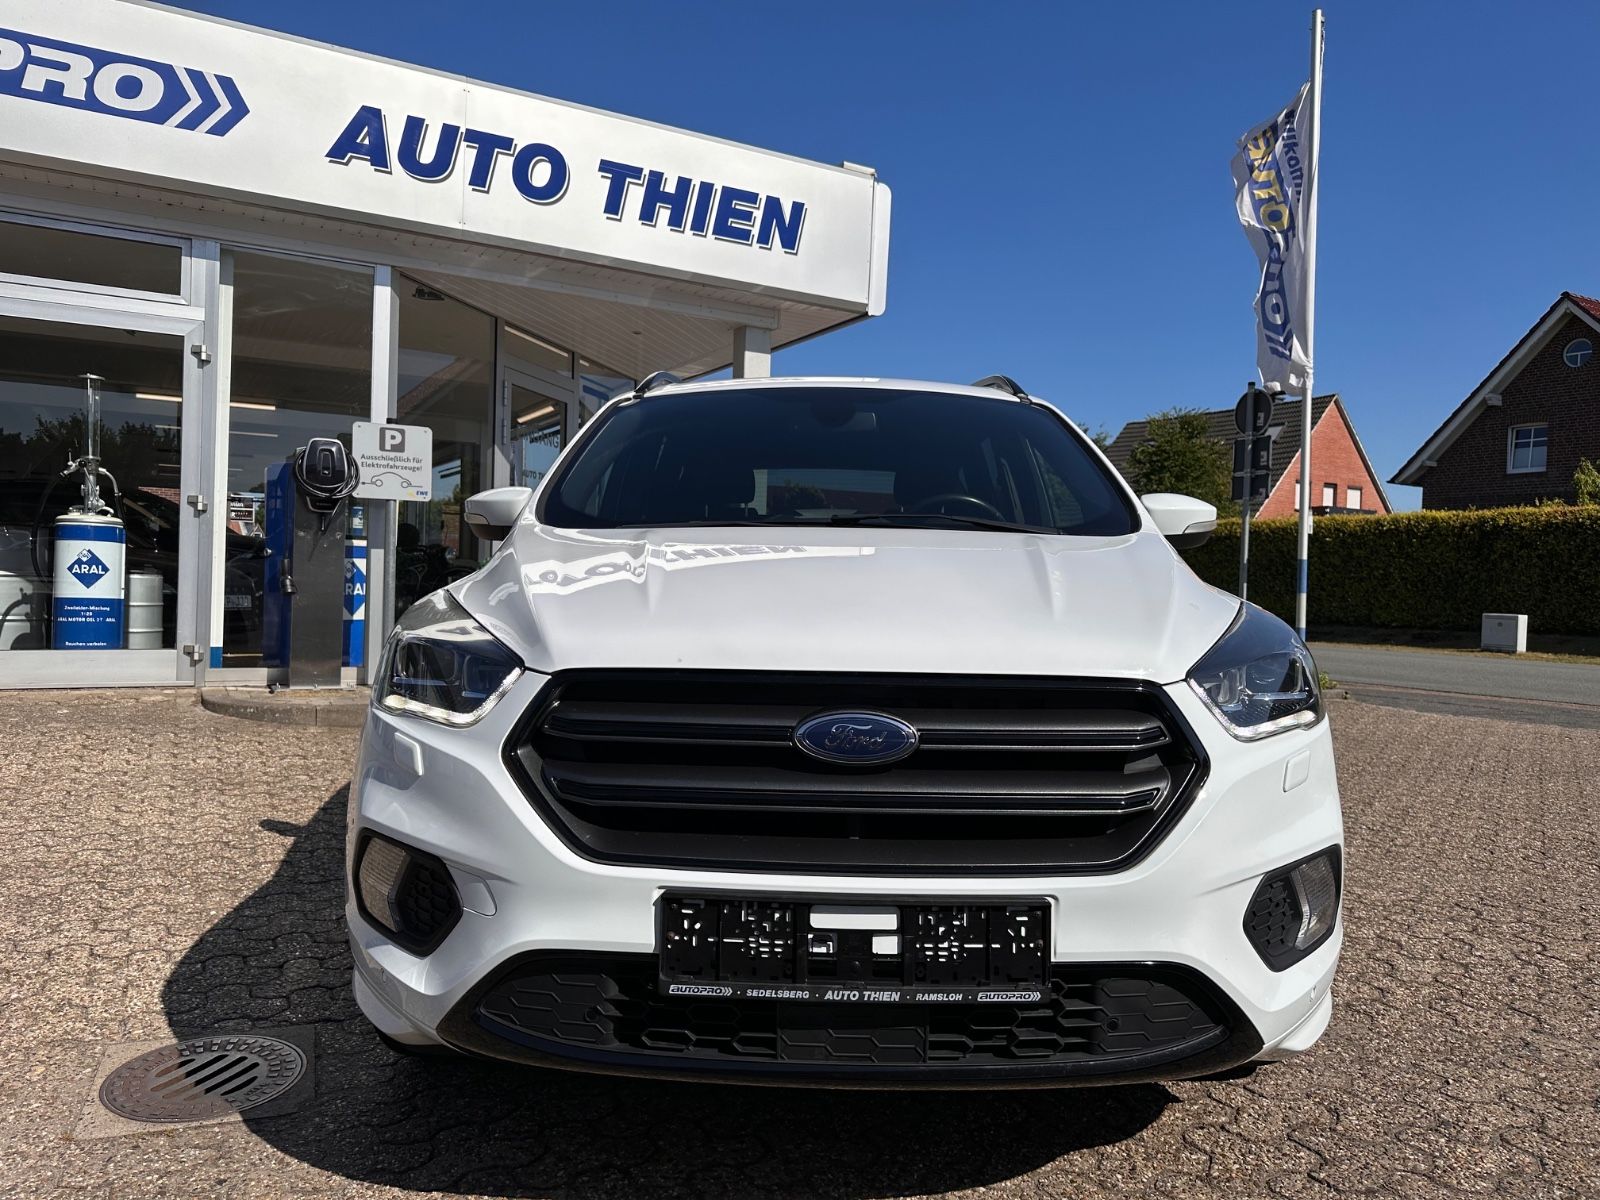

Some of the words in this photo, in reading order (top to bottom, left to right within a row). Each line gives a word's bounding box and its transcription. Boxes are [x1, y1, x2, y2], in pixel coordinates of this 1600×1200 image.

[324, 104, 570, 206] AUTO
[598, 158, 808, 256] THIEN
[384, 429, 403, 451] P
[360, 454, 411, 463] Ausschließlich
[72, 564, 106, 575] ARAL
[825, 723, 888, 750] Ford
[746, 988, 810, 999] SEDELSBERG
[824, 990, 860, 1001] AUTO
[862, 991, 900, 1002] THIEN
[915, 993, 963, 1001] RAMSLOH
